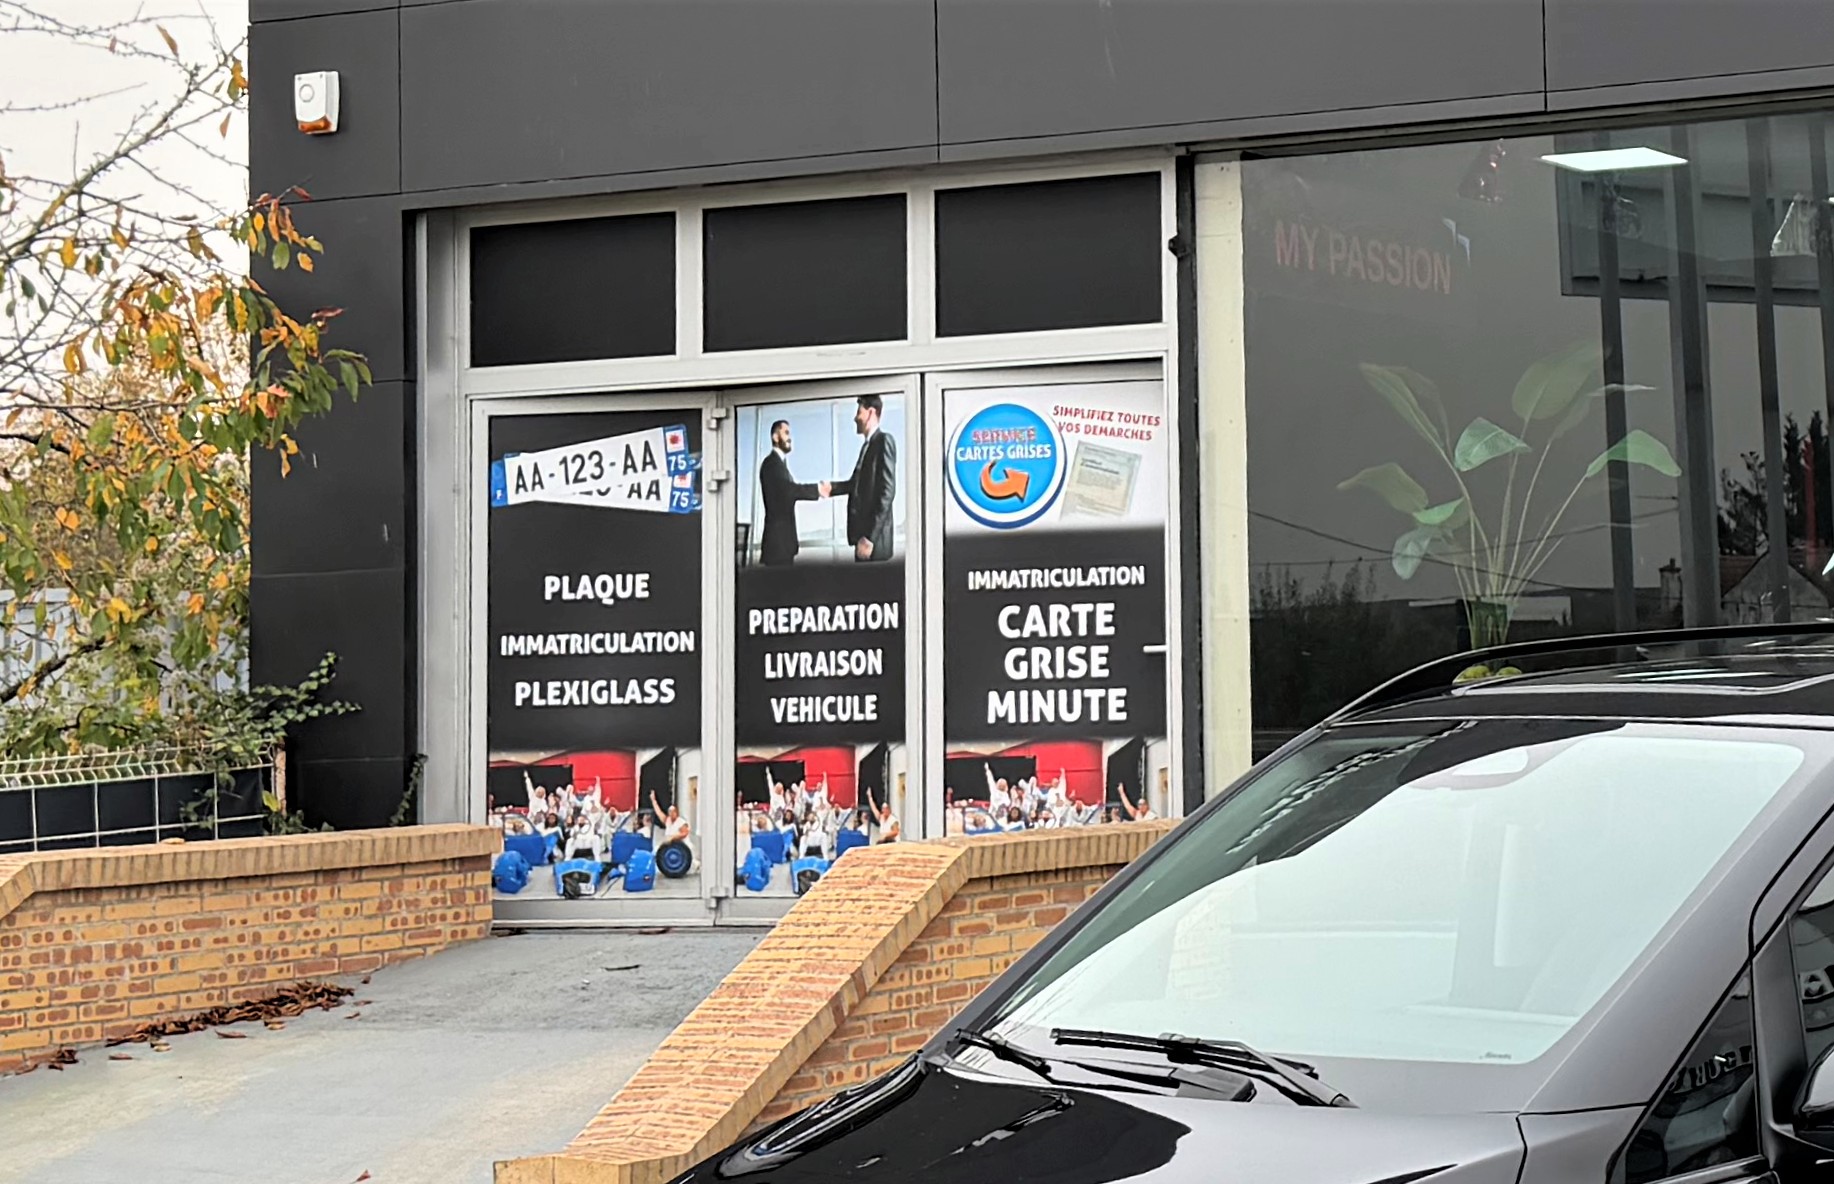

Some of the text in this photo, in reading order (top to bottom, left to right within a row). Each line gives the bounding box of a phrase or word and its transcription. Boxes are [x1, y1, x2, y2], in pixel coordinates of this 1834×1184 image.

[1274, 219, 1453, 295] MY PASSION
[1053, 405, 1161, 426] SIMPLIFIEZ TOUTES
[1057, 421, 1153, 441] VOS DEMARCHES
[668, 453, 688, 472] 75
[956, 443, 1051, 461] CARTES GRISES
[672, 490, 690, 508] 75
[544, 572, 651, 605] PLAQUE
[967, 565, 1146, 590] IMMATRICULATION
[748, 602, 899, 635] PREPARATION
[998, 602, 1116, 639] CARTE
[500, 630, 696, 656] IMMATRICULATION
[764, 648, 884, 679] LIVRAISON
[1003, 645, 1110, 681] GRISE
[514, 678, 676, 706] PLEXIGLASS
[987, 687, 1128, 724] MINUTE
[770, 694, 878, 723] VEHICULE
